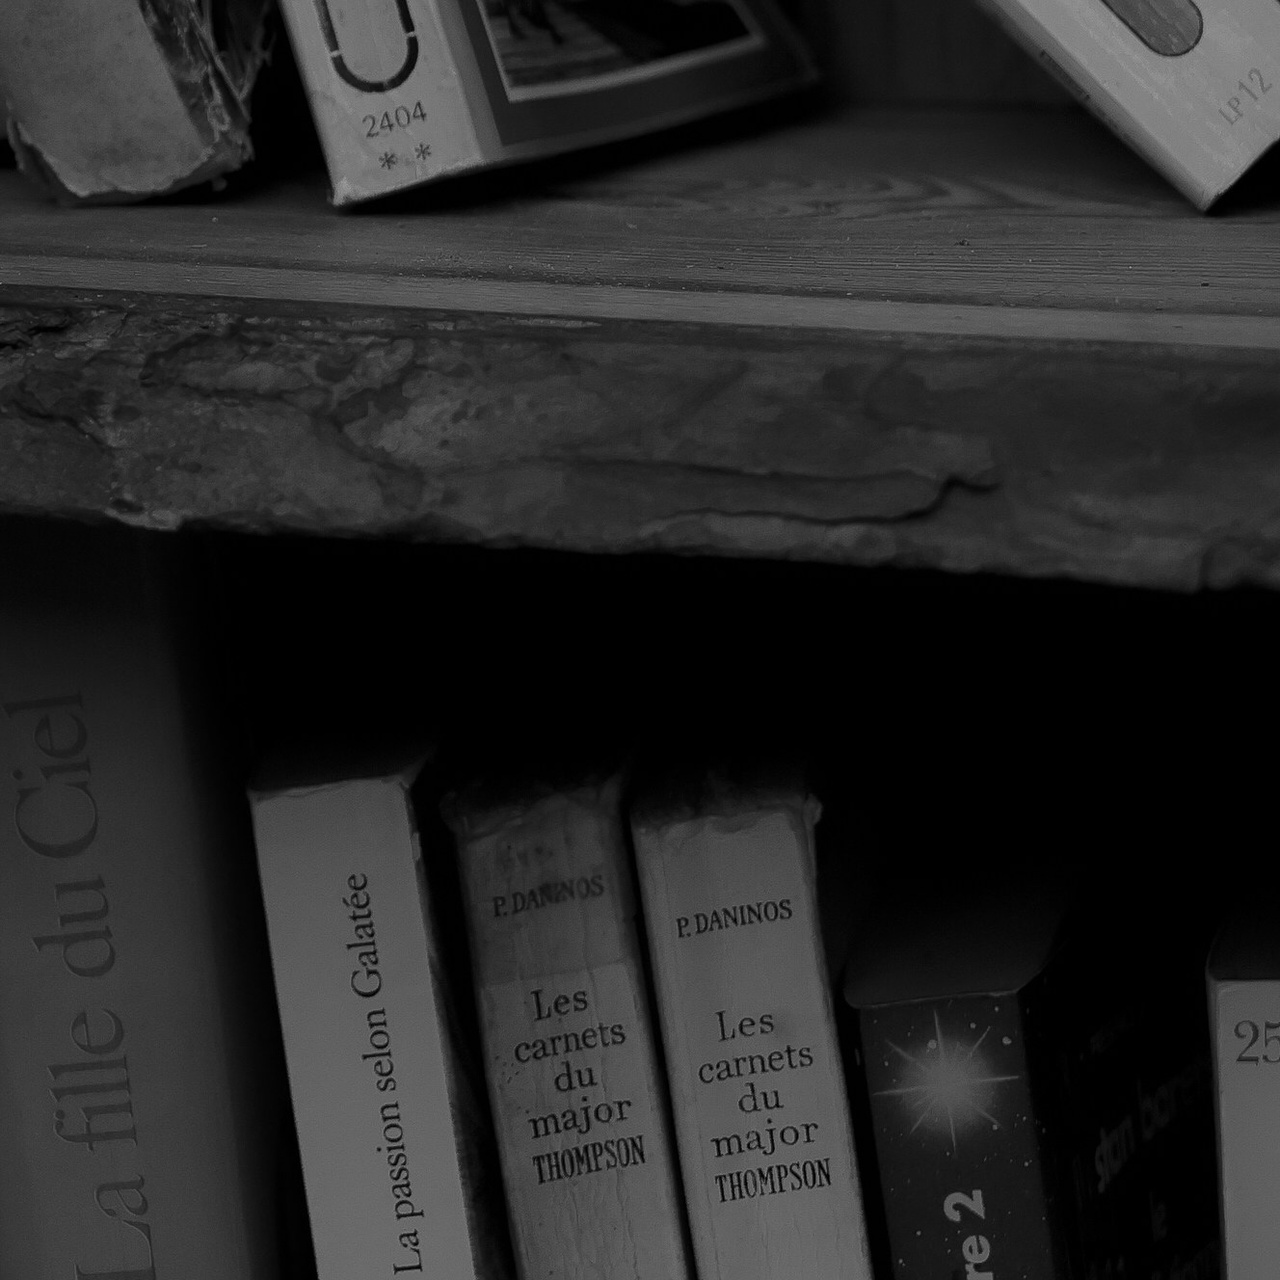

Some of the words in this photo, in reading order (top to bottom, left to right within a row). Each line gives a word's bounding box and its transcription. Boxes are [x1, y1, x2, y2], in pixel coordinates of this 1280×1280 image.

[1232, 65, 1274, 104] 12
[361, 101, 429, 140] 2404
[2, 690, 101, 860] Ciel
[511, 874, 605, 914] DANINOS
[32, 873, 118, 979] du
[342, 870, 383, 998] Galatée
[694, 898, 794, 936] DANINOS
[530, 988, 589, 1021] Les
[716, 1010, 776, 1042] Les
[361, 1006, 398, 1094] selon
[513, 1020, 627, 1064] carnets
[697, 1042, 814, 1085] carnets
[47, 1007, 139, 1153] fille
[553, 1062, 598, 1094] du
[737, 1083, 785, 1115] du
[528, 1098, 632, 1140] major
[710, 1117, 819, 1158] major
[376, 1102, 425, 1219] passion
[532, 1134, 646, 1185] THOMPSON
[714, 1157, 833, 1204] THOMPSON
[73, 1172, 157, 1280] La
[943, 1187, 988, 1222] 2
[393, 1230, 423, 1276] La
